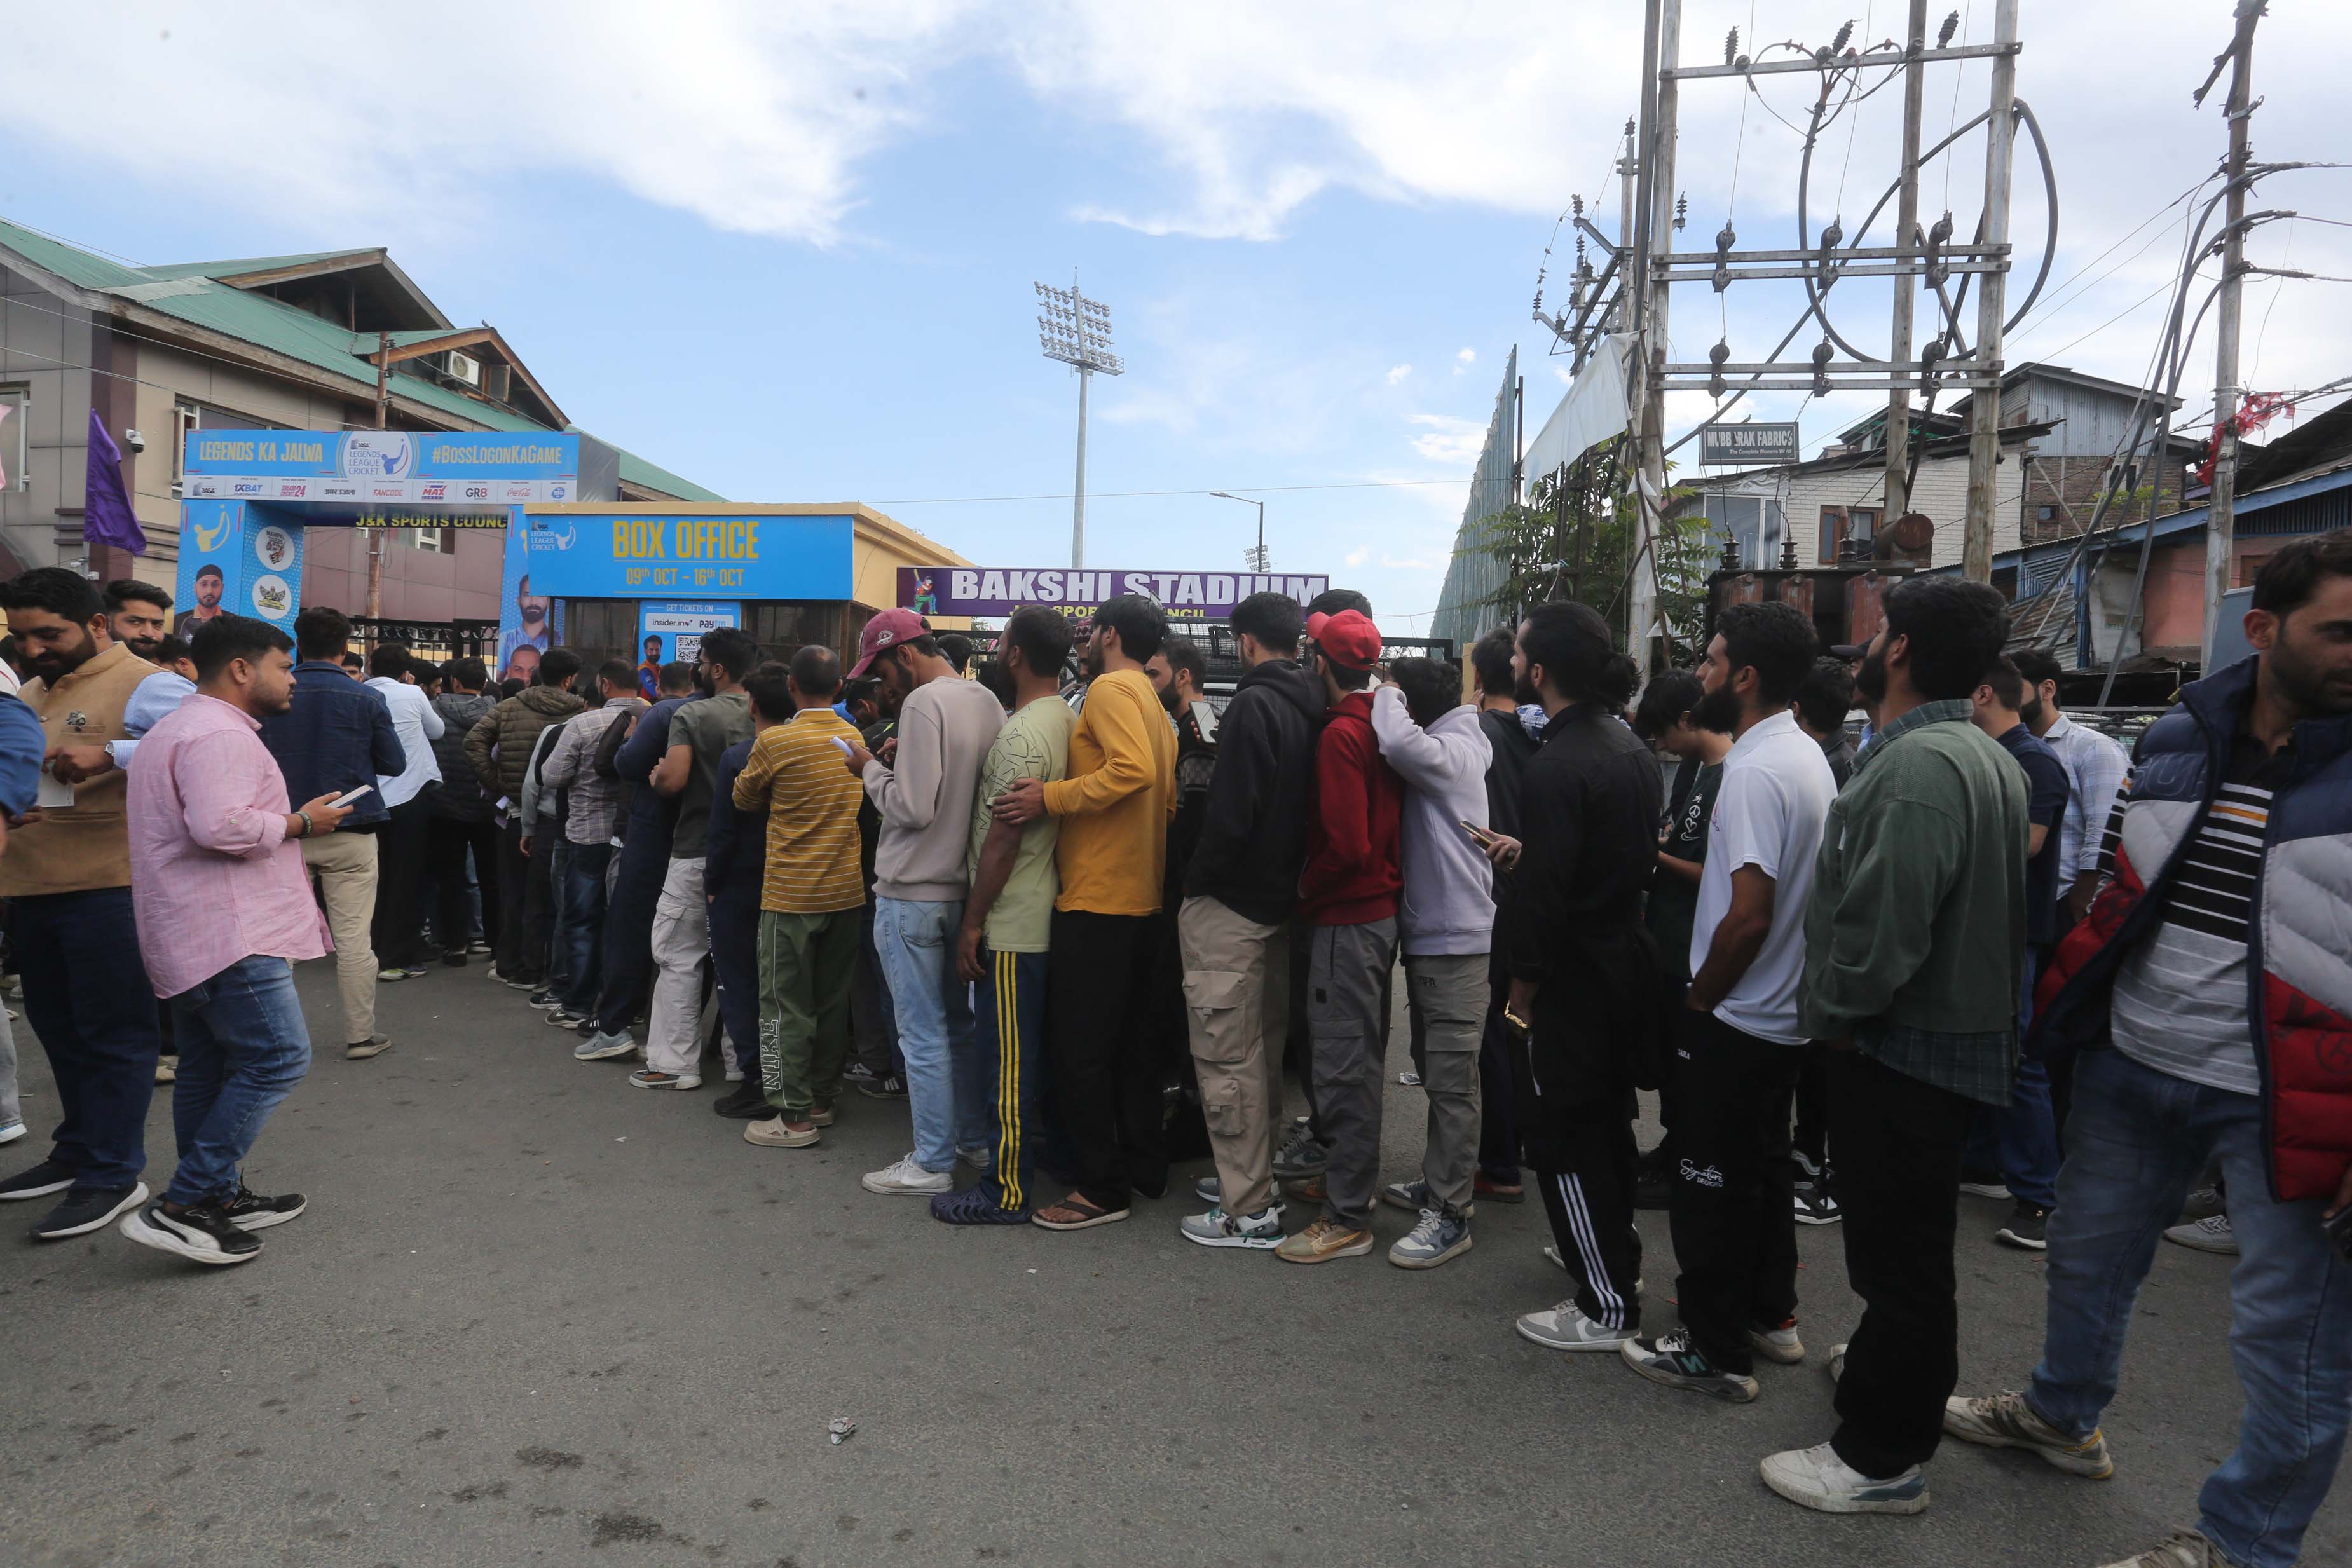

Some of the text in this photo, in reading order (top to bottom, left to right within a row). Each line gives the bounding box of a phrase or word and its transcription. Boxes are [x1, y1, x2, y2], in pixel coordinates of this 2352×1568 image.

[1757, 430, 1793, 446] FABRICS
[200, 441, 323, 462] LEGENDS KA JALWA
[234, 484, 263, 493] 1XBAT
[295, 485, 306, 497] 24
[465, 487, 488, 498] GR8
[391, 514, 449, 527] SPORTS
[613, 521, 759, 559] BOX OFFICE
[626, 567, 650, 585] 09th
[653, 568, 678, 585] OCT
[695, 568, 715, 586] 16th
[720, 569, 744, 586] OCT
[951, 570, 1112, 602] BAKSHI
[652, 618, 726, 628] insider.in paytm
[758, 1019, 781, 1091] NIKE
